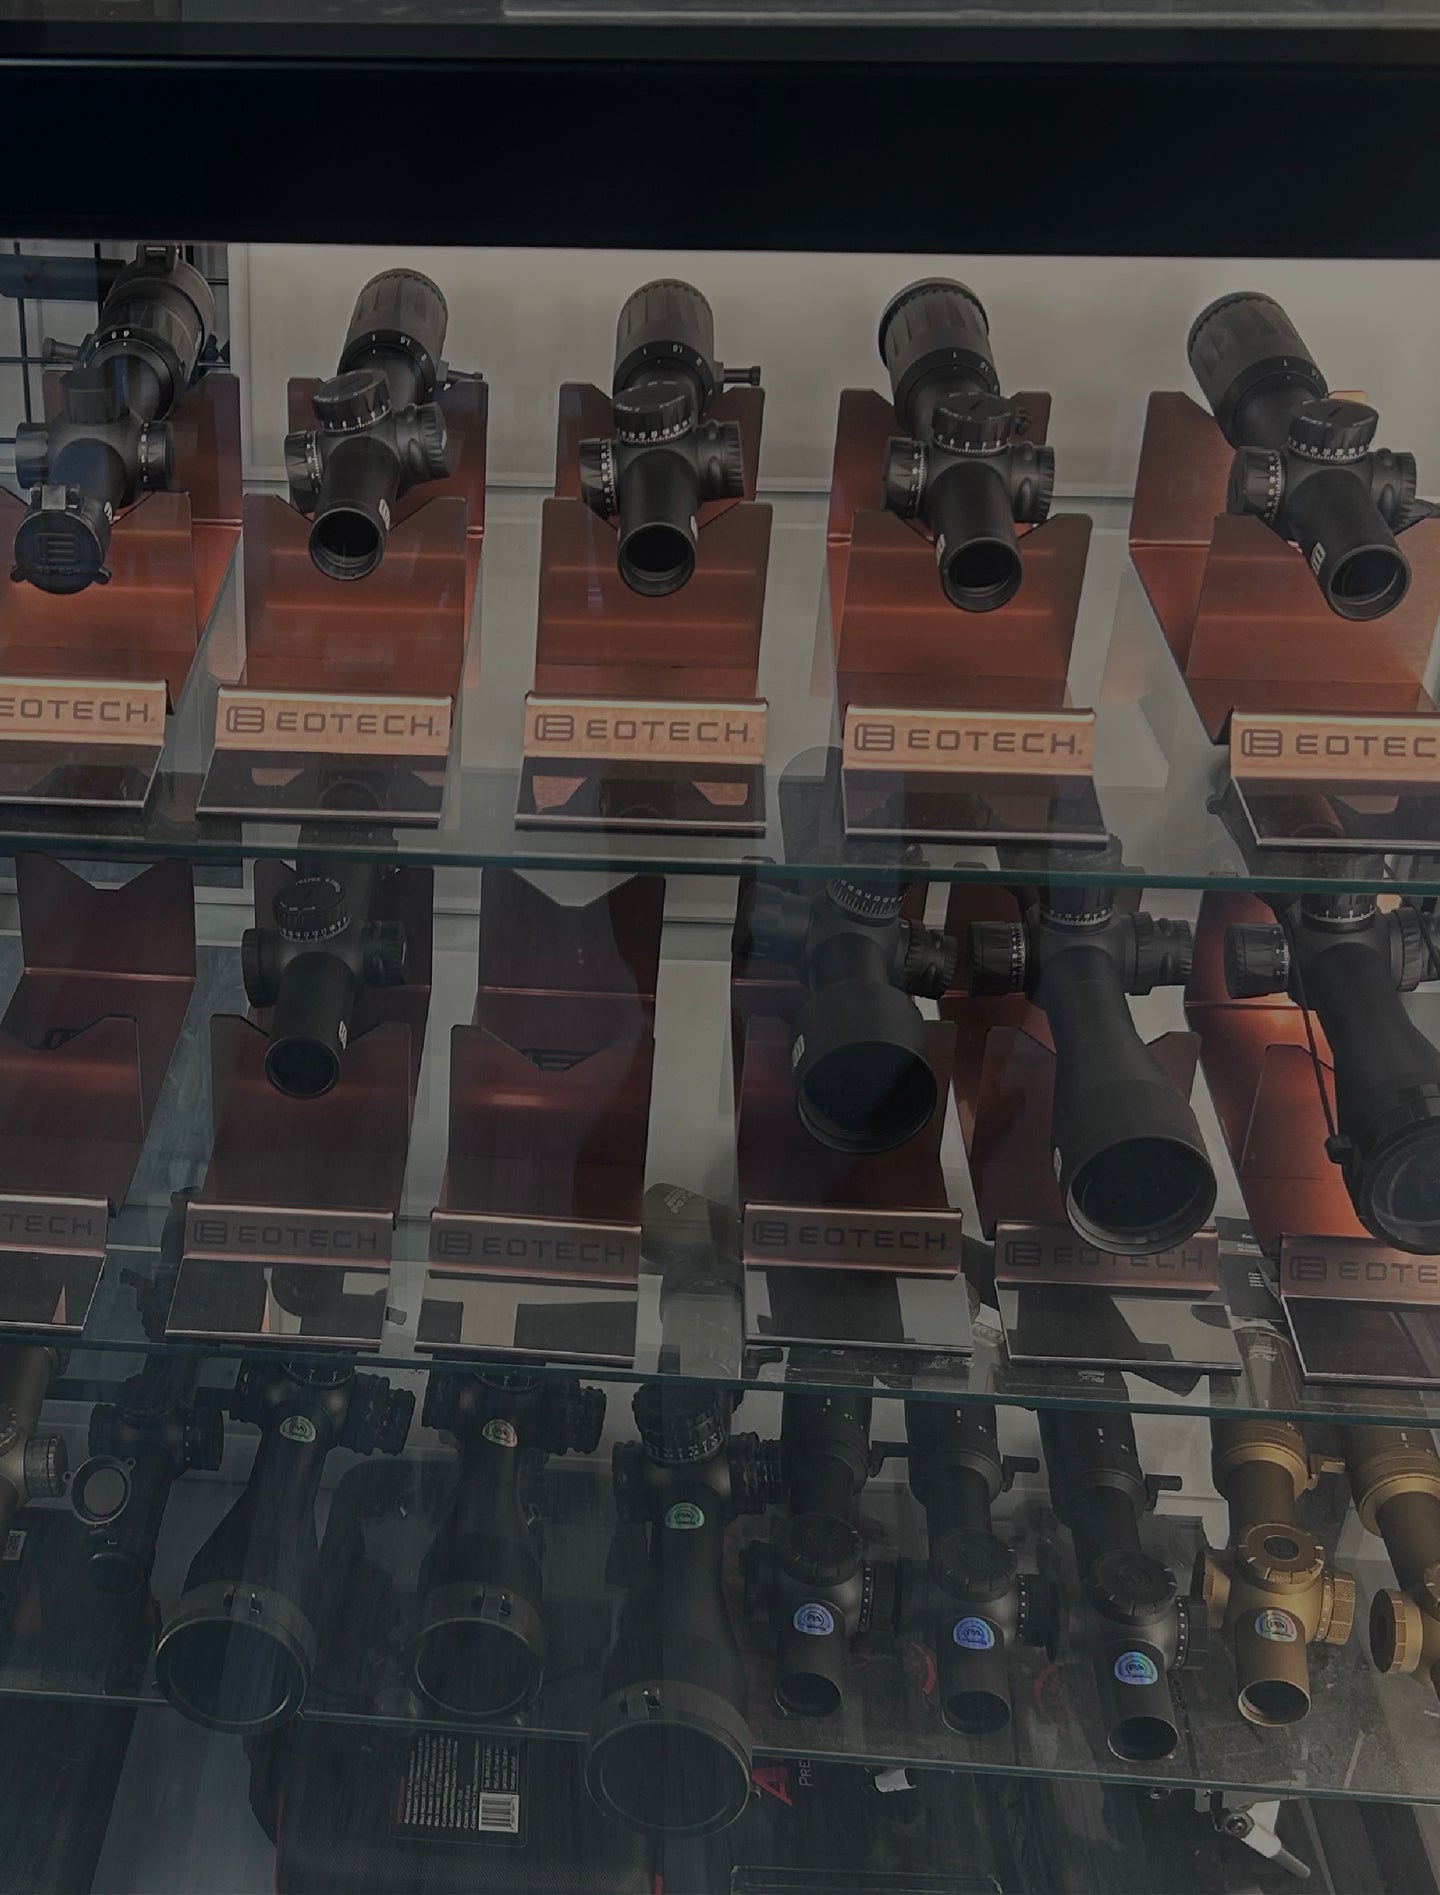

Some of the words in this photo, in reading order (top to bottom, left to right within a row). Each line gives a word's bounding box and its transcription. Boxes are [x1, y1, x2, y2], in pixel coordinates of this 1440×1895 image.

[276, 710, 436, 737] EOTECH
[586, 720, 750, 743] EOTECH
[907, 729, 1077, 754] EOTECH
[239, 1226, 378, 1250] EOTECH
[799, 1228, 946, 1252] EOTECH
[482, 1240, 627, 1264] EOTECH
